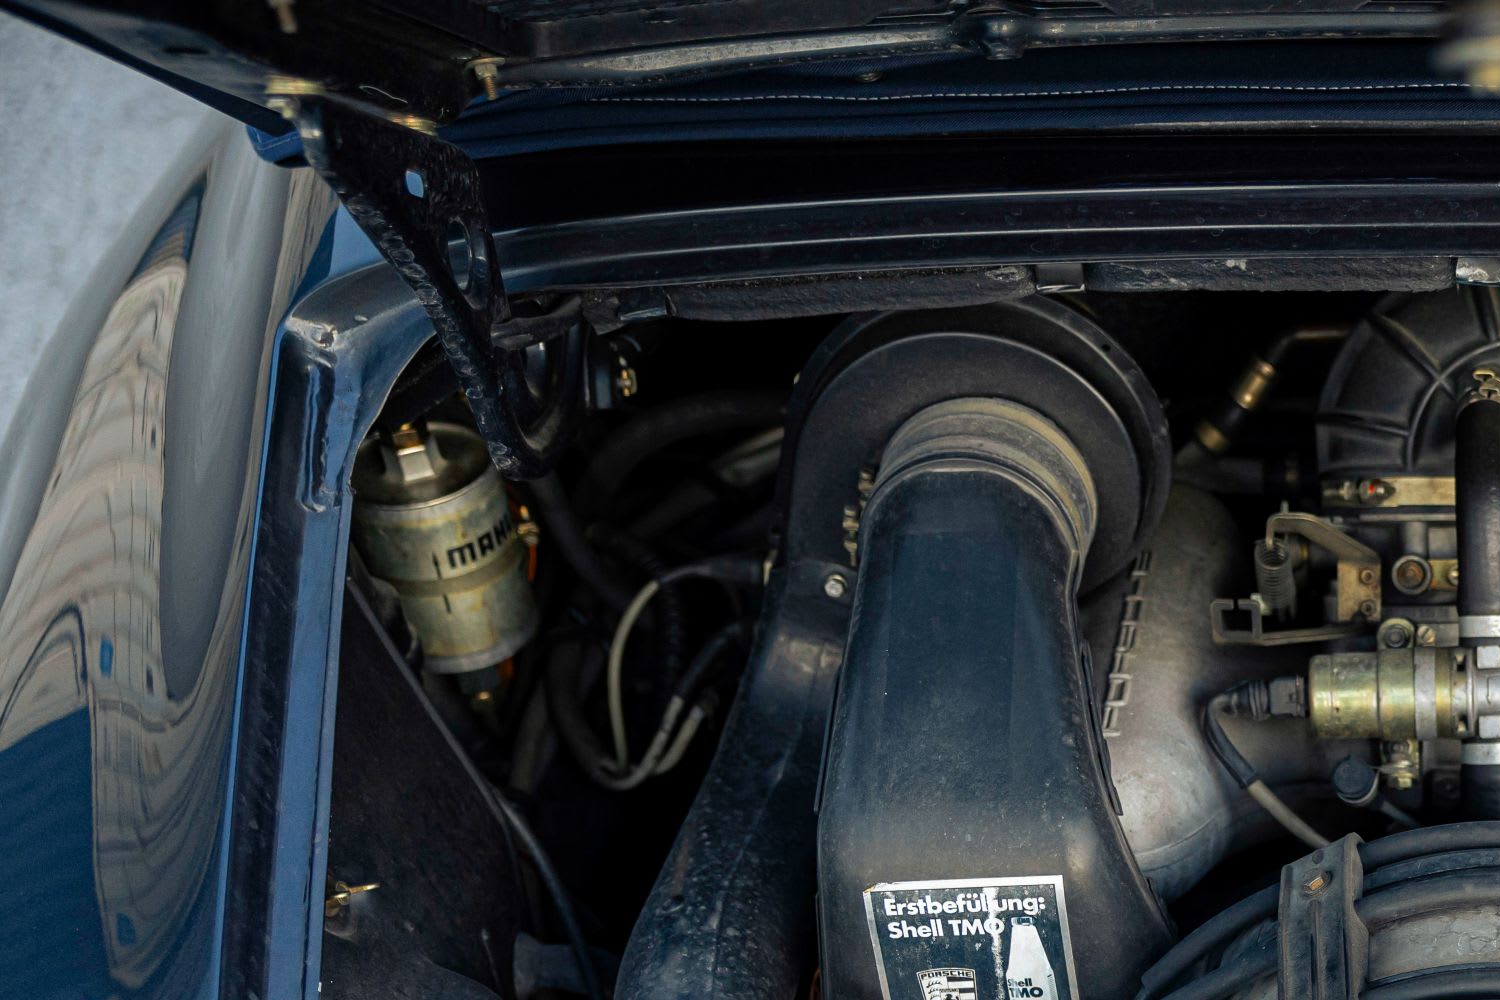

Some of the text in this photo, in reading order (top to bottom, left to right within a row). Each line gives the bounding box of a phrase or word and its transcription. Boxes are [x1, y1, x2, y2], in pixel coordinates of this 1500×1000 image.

[887, 917, 1005, 939] Shell TMO
[920, 970, 972, 979] PORSCHE
[1007, 978, 1033, 987] Shell
[1008, 986, 1044, 998] TMO
